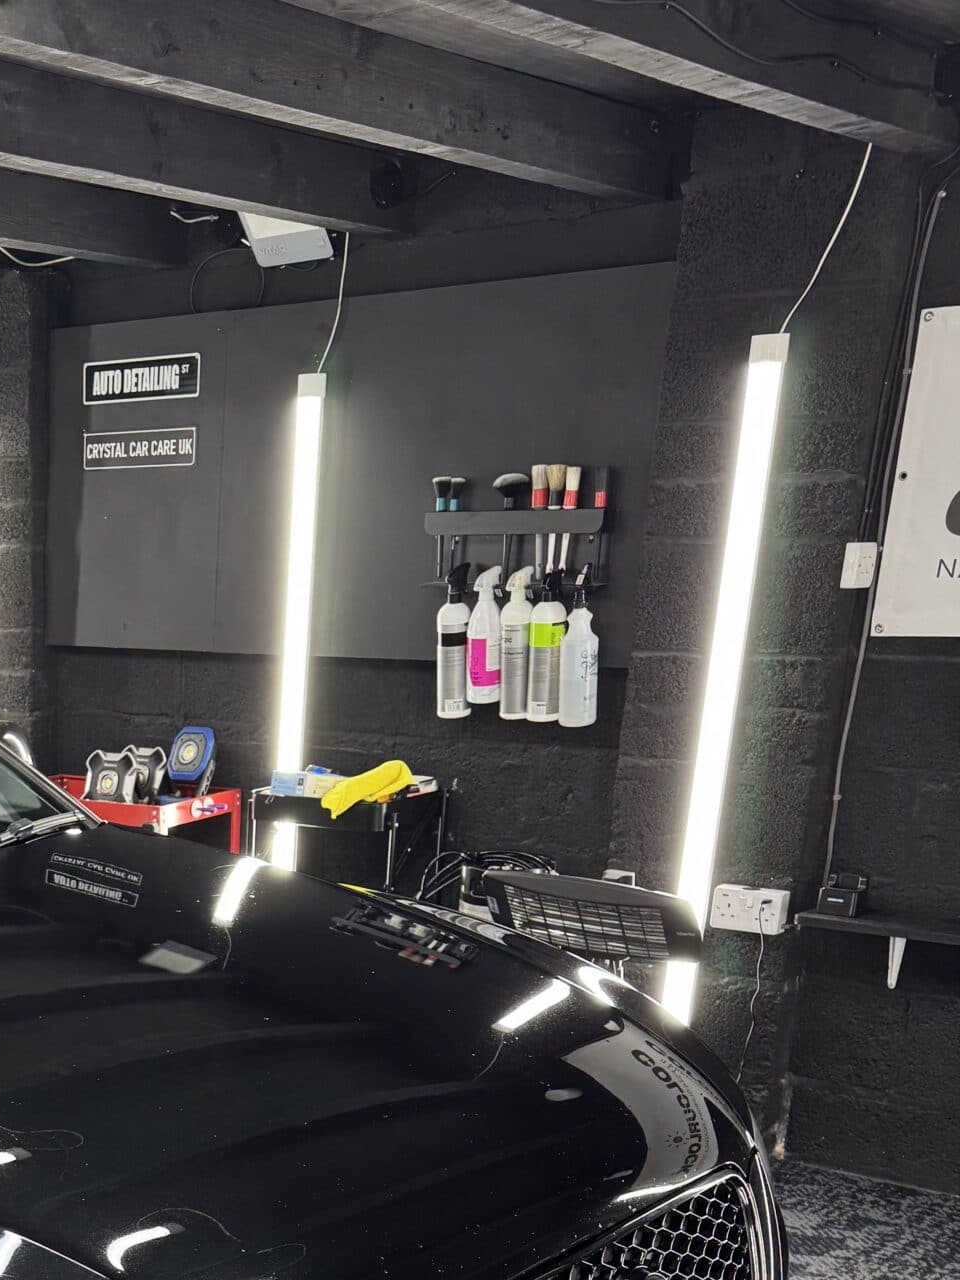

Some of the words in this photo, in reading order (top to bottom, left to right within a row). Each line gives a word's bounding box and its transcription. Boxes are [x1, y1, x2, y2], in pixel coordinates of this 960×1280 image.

[92, 369, 122, 396] AUTO
[123, 364, 180, 393] DETAILING
[181, 364, 190, 374] ST
[86, 441, 128, 459] CRYSTAL
[129, 440, 149, 457] CAR
[150, 439, 177, 456] CARE
[178, 438, 193, 455] UK
[936, 558, 960, 578] N
